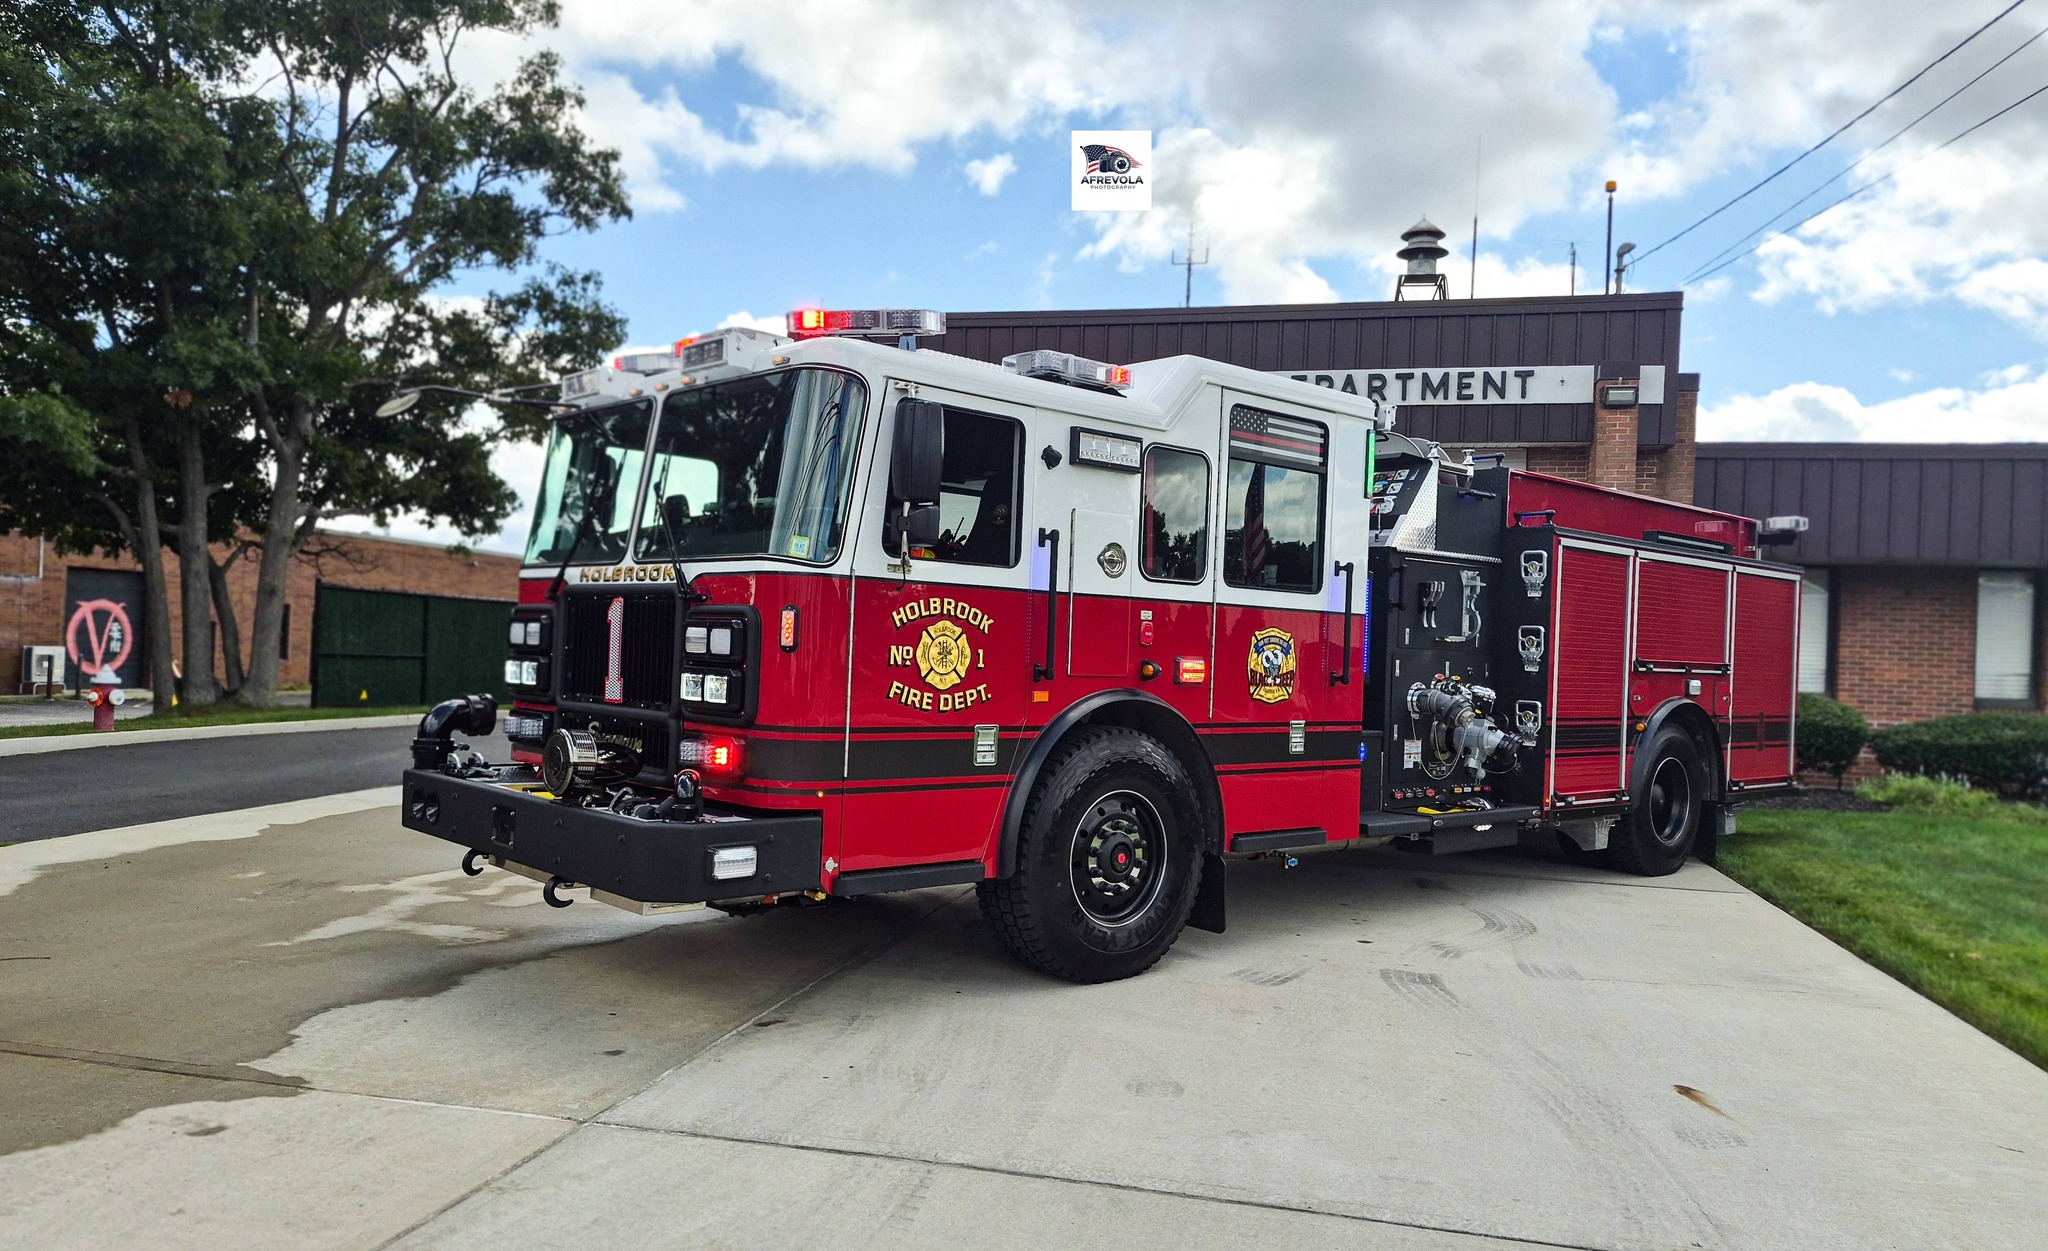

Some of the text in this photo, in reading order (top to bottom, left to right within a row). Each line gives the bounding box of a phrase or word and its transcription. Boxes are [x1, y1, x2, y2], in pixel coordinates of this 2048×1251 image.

[1291, 369, 1535, 401] PARTMENT
[580, 565, 676, 582] HOLBROOK
[891, 597, 995, 634] HOLBROOK
[933, 626, 956, 636] HOLBROOK
[604, 597, 624, 703] 1
[976, 649, 985, 668] 1
[887, 680, 992, 713] FIRE DEPT.
